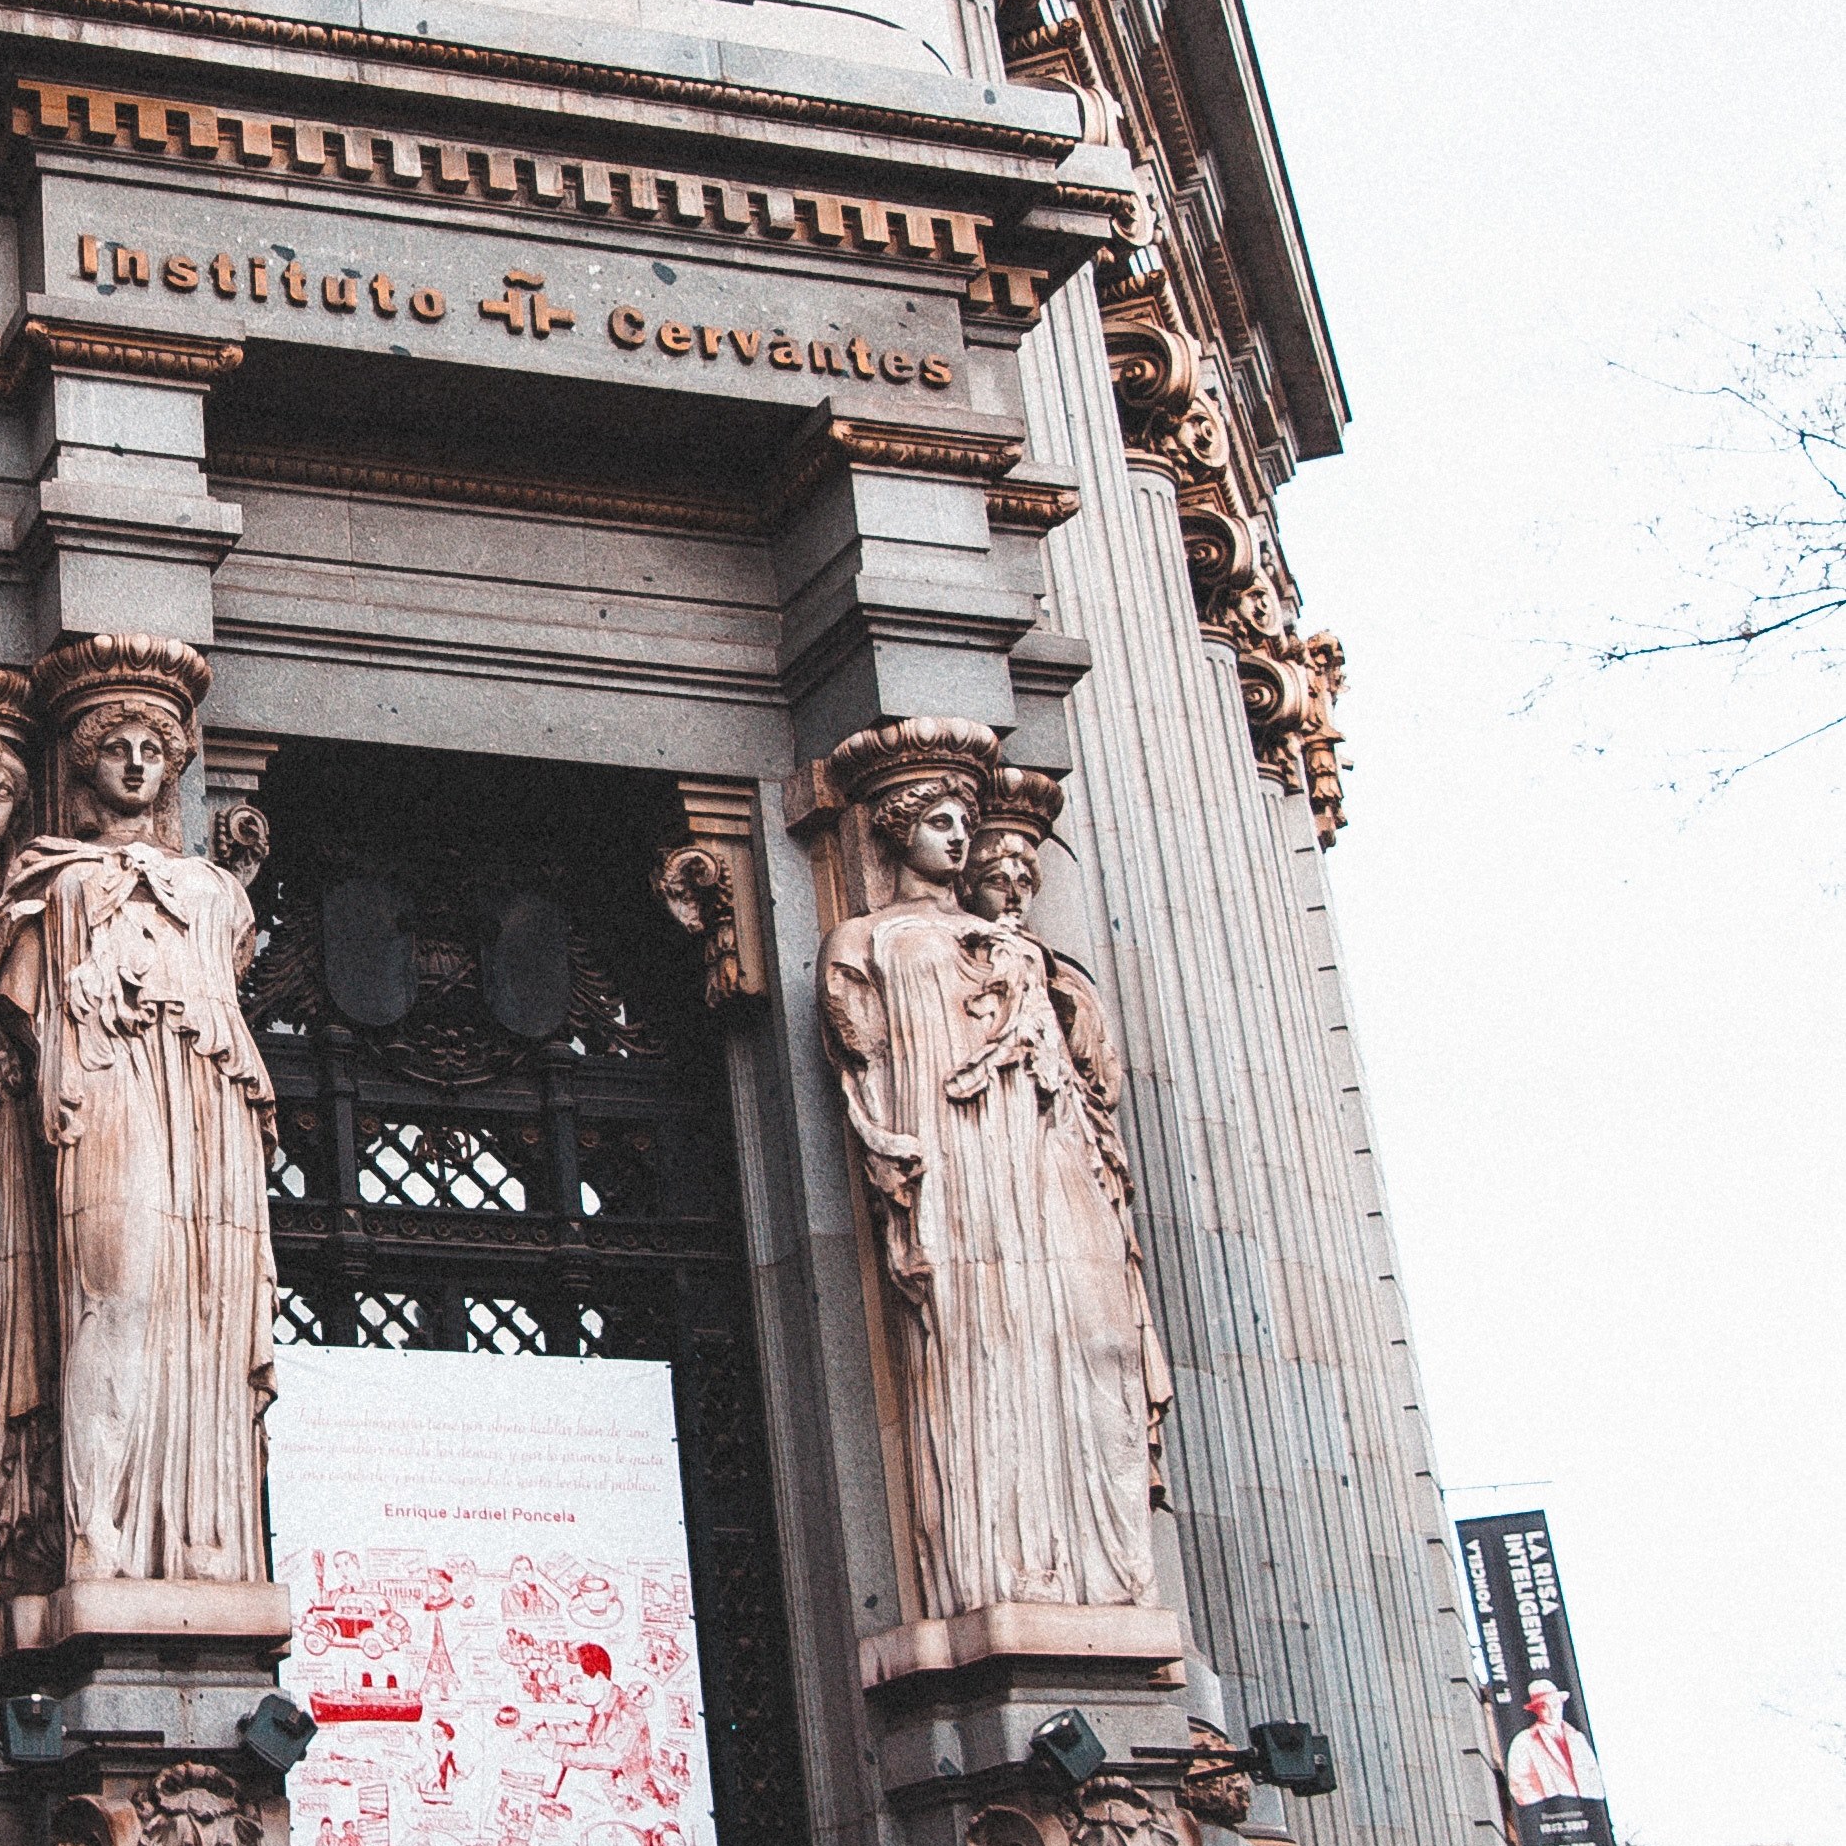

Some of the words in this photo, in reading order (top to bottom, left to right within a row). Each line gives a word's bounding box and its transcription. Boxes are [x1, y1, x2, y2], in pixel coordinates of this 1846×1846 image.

[78, 233, 446, 323] Instituto
[607, 304, 953, 389] Cervantes
[384, 1502, 447, 1521] Enrique
[453, 1505, 507, 1521] Jardiel
[512, 1507, 576, 1524] Poncela
[1525, 1530, 1548, 1562] LA
[1502, 1533, 1551, 1671] INTELIGENTE
[1533, 1562, 1560, 1616] RISA
